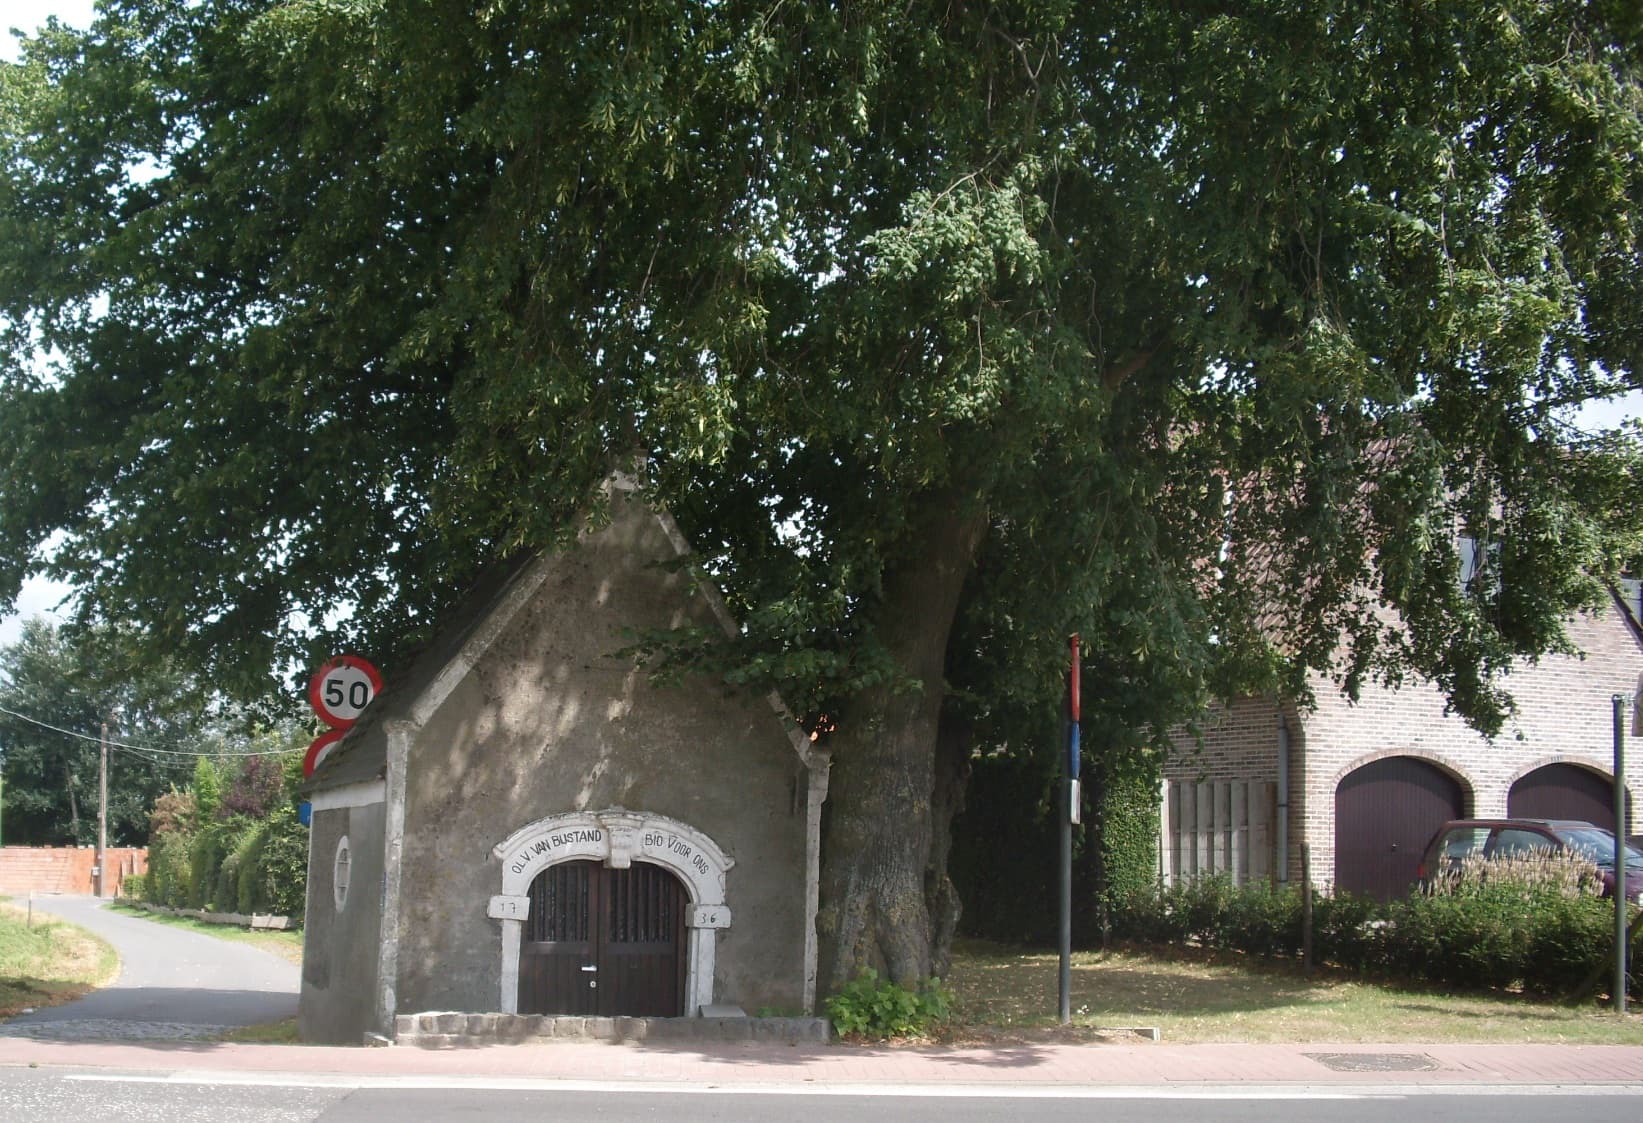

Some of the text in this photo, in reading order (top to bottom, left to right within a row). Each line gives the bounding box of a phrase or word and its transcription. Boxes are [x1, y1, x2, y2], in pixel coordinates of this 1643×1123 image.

[325, 679, 369, 710] 50
[530, 839, 551, 855] VAN
[667, 834, 692, 858] VOOR
[692, 854, 710, 875] ONS
[701, 912, 717, 924] 36
